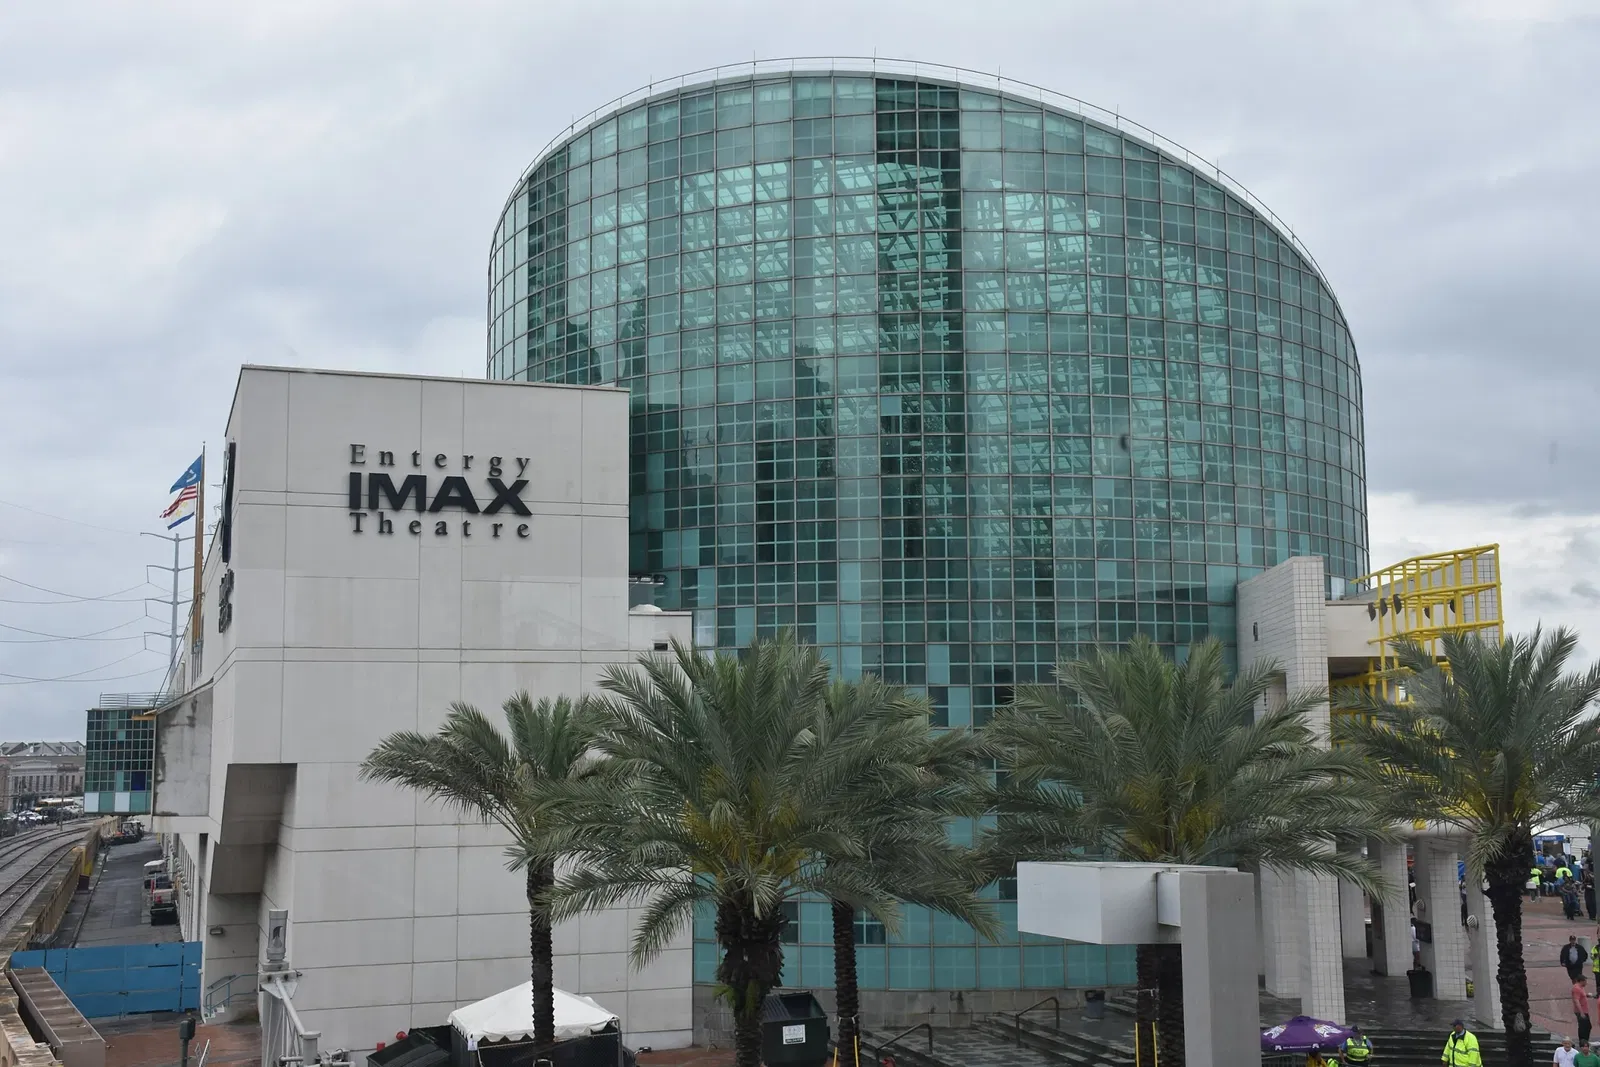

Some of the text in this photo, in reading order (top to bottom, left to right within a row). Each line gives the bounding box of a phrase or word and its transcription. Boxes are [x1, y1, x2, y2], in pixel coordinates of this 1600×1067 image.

[350, 444, 530, 477] Entergy
[349, 472, 532, 516] IMAX
[350, 511, 530, 538] Theatre
